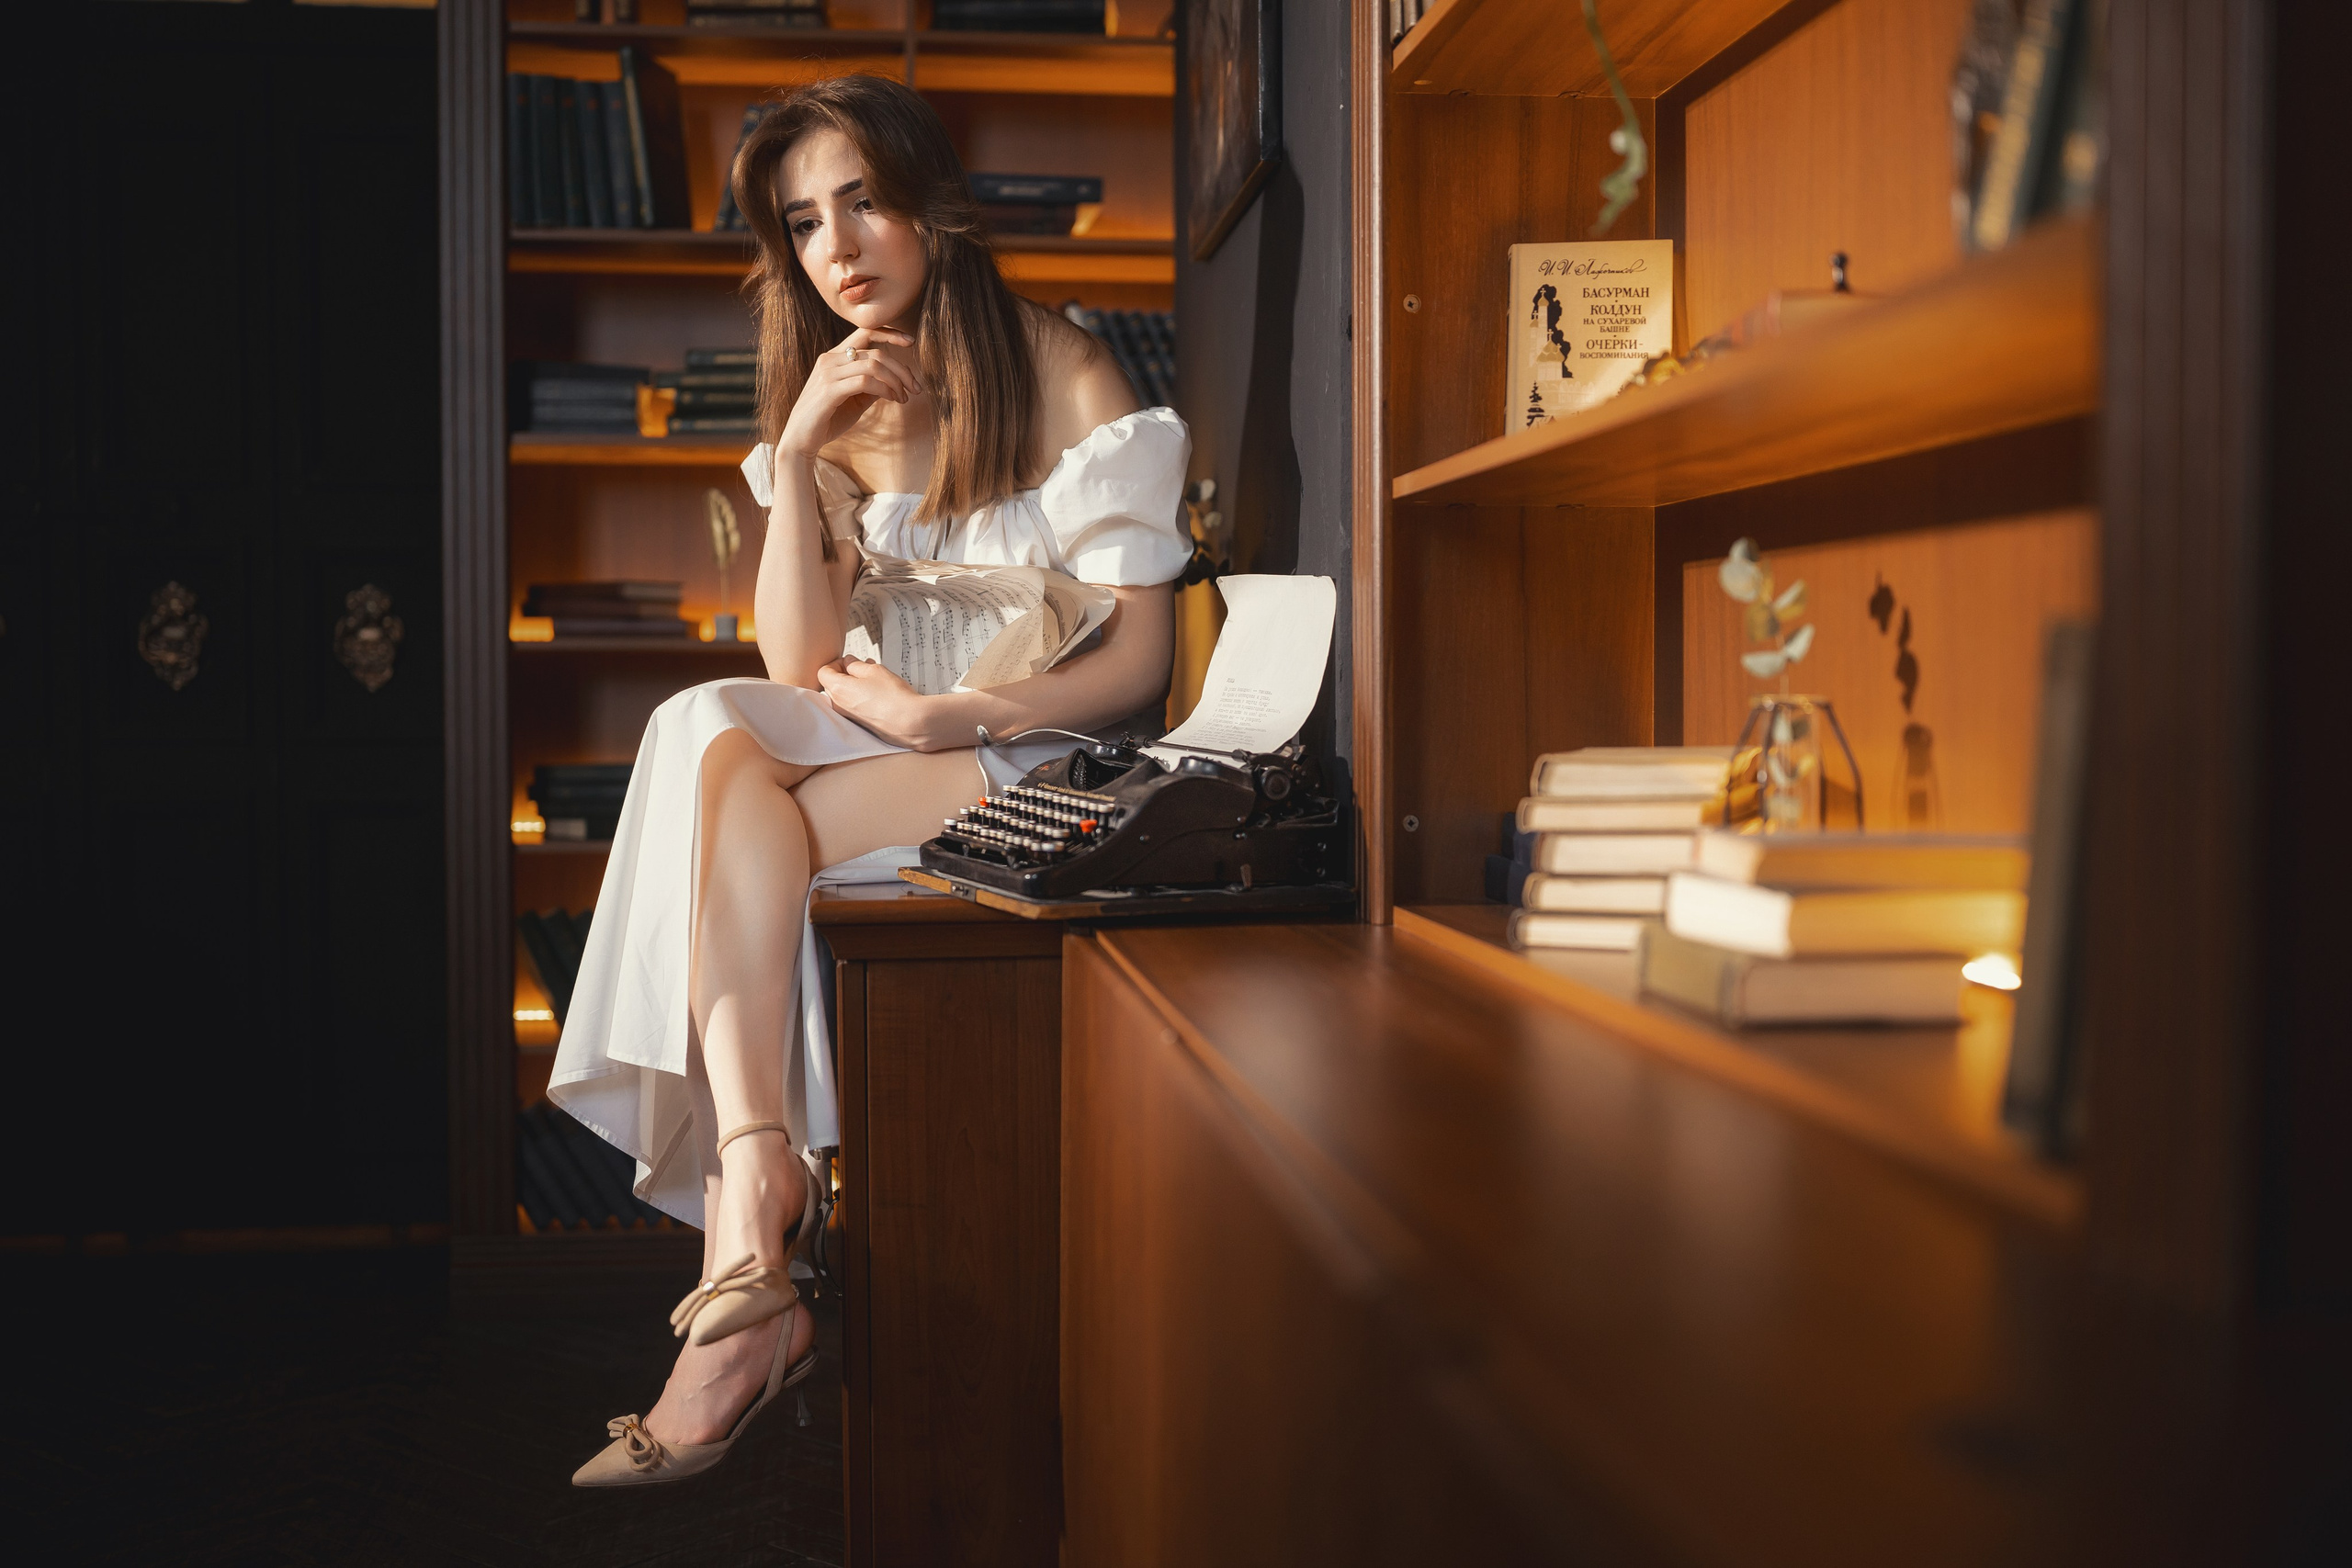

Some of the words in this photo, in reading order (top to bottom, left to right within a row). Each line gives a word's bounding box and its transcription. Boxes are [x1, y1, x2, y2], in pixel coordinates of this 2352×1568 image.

[1582, 287, 1650, 299] БАСУРМАН
[1589, 304, 1642, 317] КОЛДУН
[1597, 316, 1646, 325] СУХАРЕВОЙ
[1579, 352, 1649, 360] ВОСПОМИНАНИЯ
